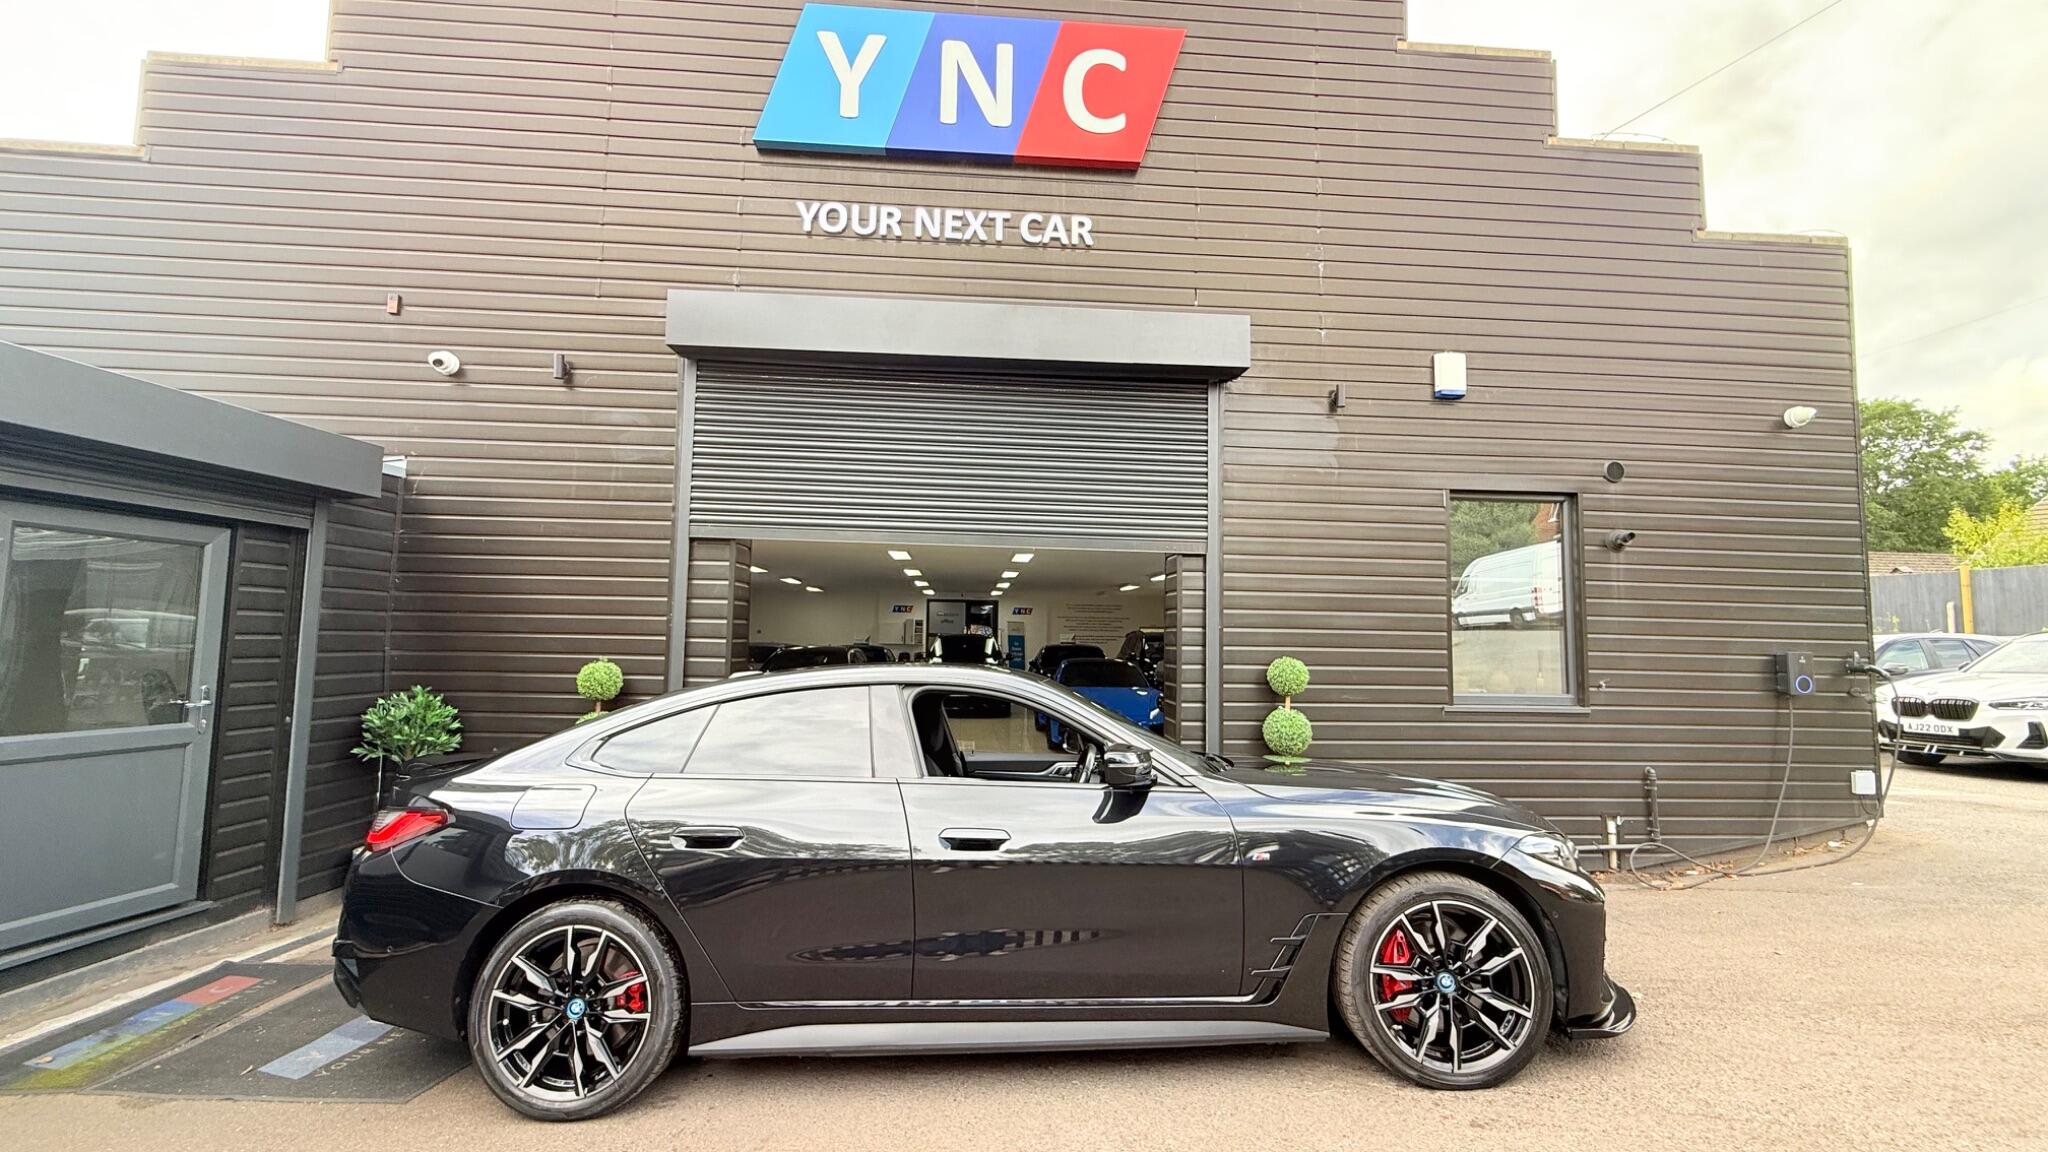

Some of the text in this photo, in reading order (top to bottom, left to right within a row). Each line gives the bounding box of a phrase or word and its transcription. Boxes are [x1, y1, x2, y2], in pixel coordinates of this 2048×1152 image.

[816, 30, 1127, 134] YNC
[796, 201, 1094, 246] YOUR NEXT CAR
[1908, 722, 1930, 731] AJ22
